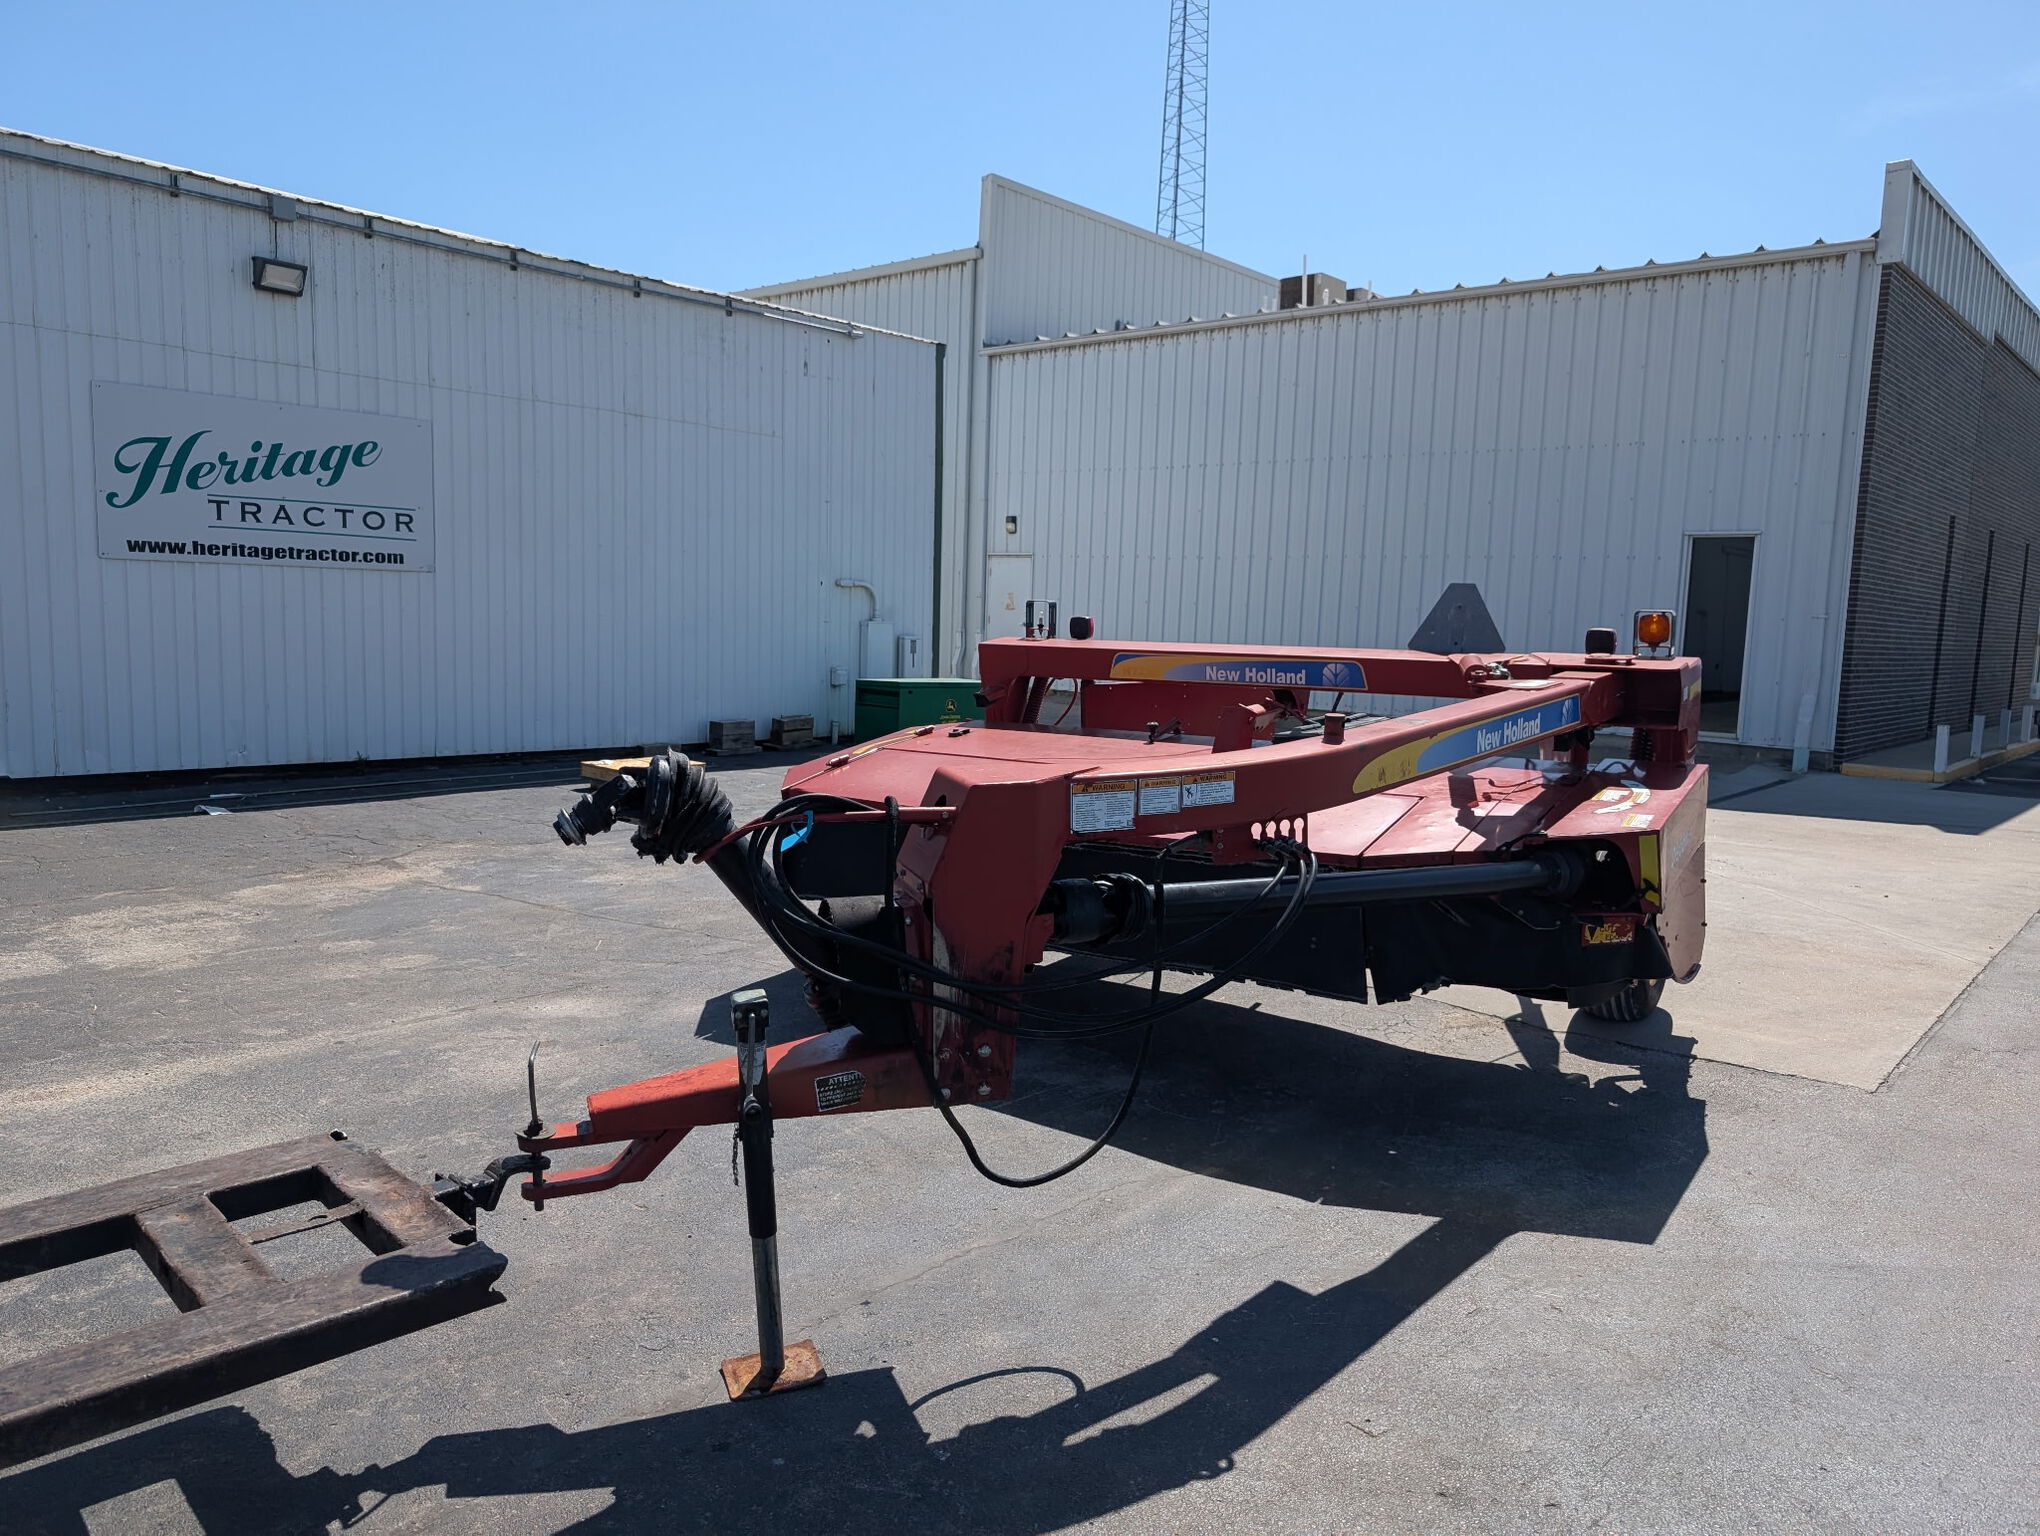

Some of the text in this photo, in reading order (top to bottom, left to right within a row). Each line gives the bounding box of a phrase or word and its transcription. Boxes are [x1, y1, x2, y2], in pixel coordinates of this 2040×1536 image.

[106, 430, 383, 508] Heritage
[207, 499, 415, 533] TRACTOR
[126, 539, 405, 565] www.heritagetractor.com
[1205, 665, 1306, 685] New Holland
[1476, 712, 1541, 754] New Holland
[1092, 783, 1126, 791] WARNING
[1151, 779, 1177, 787] WARNING
[1200, 774, 1227, 782] WARNING
